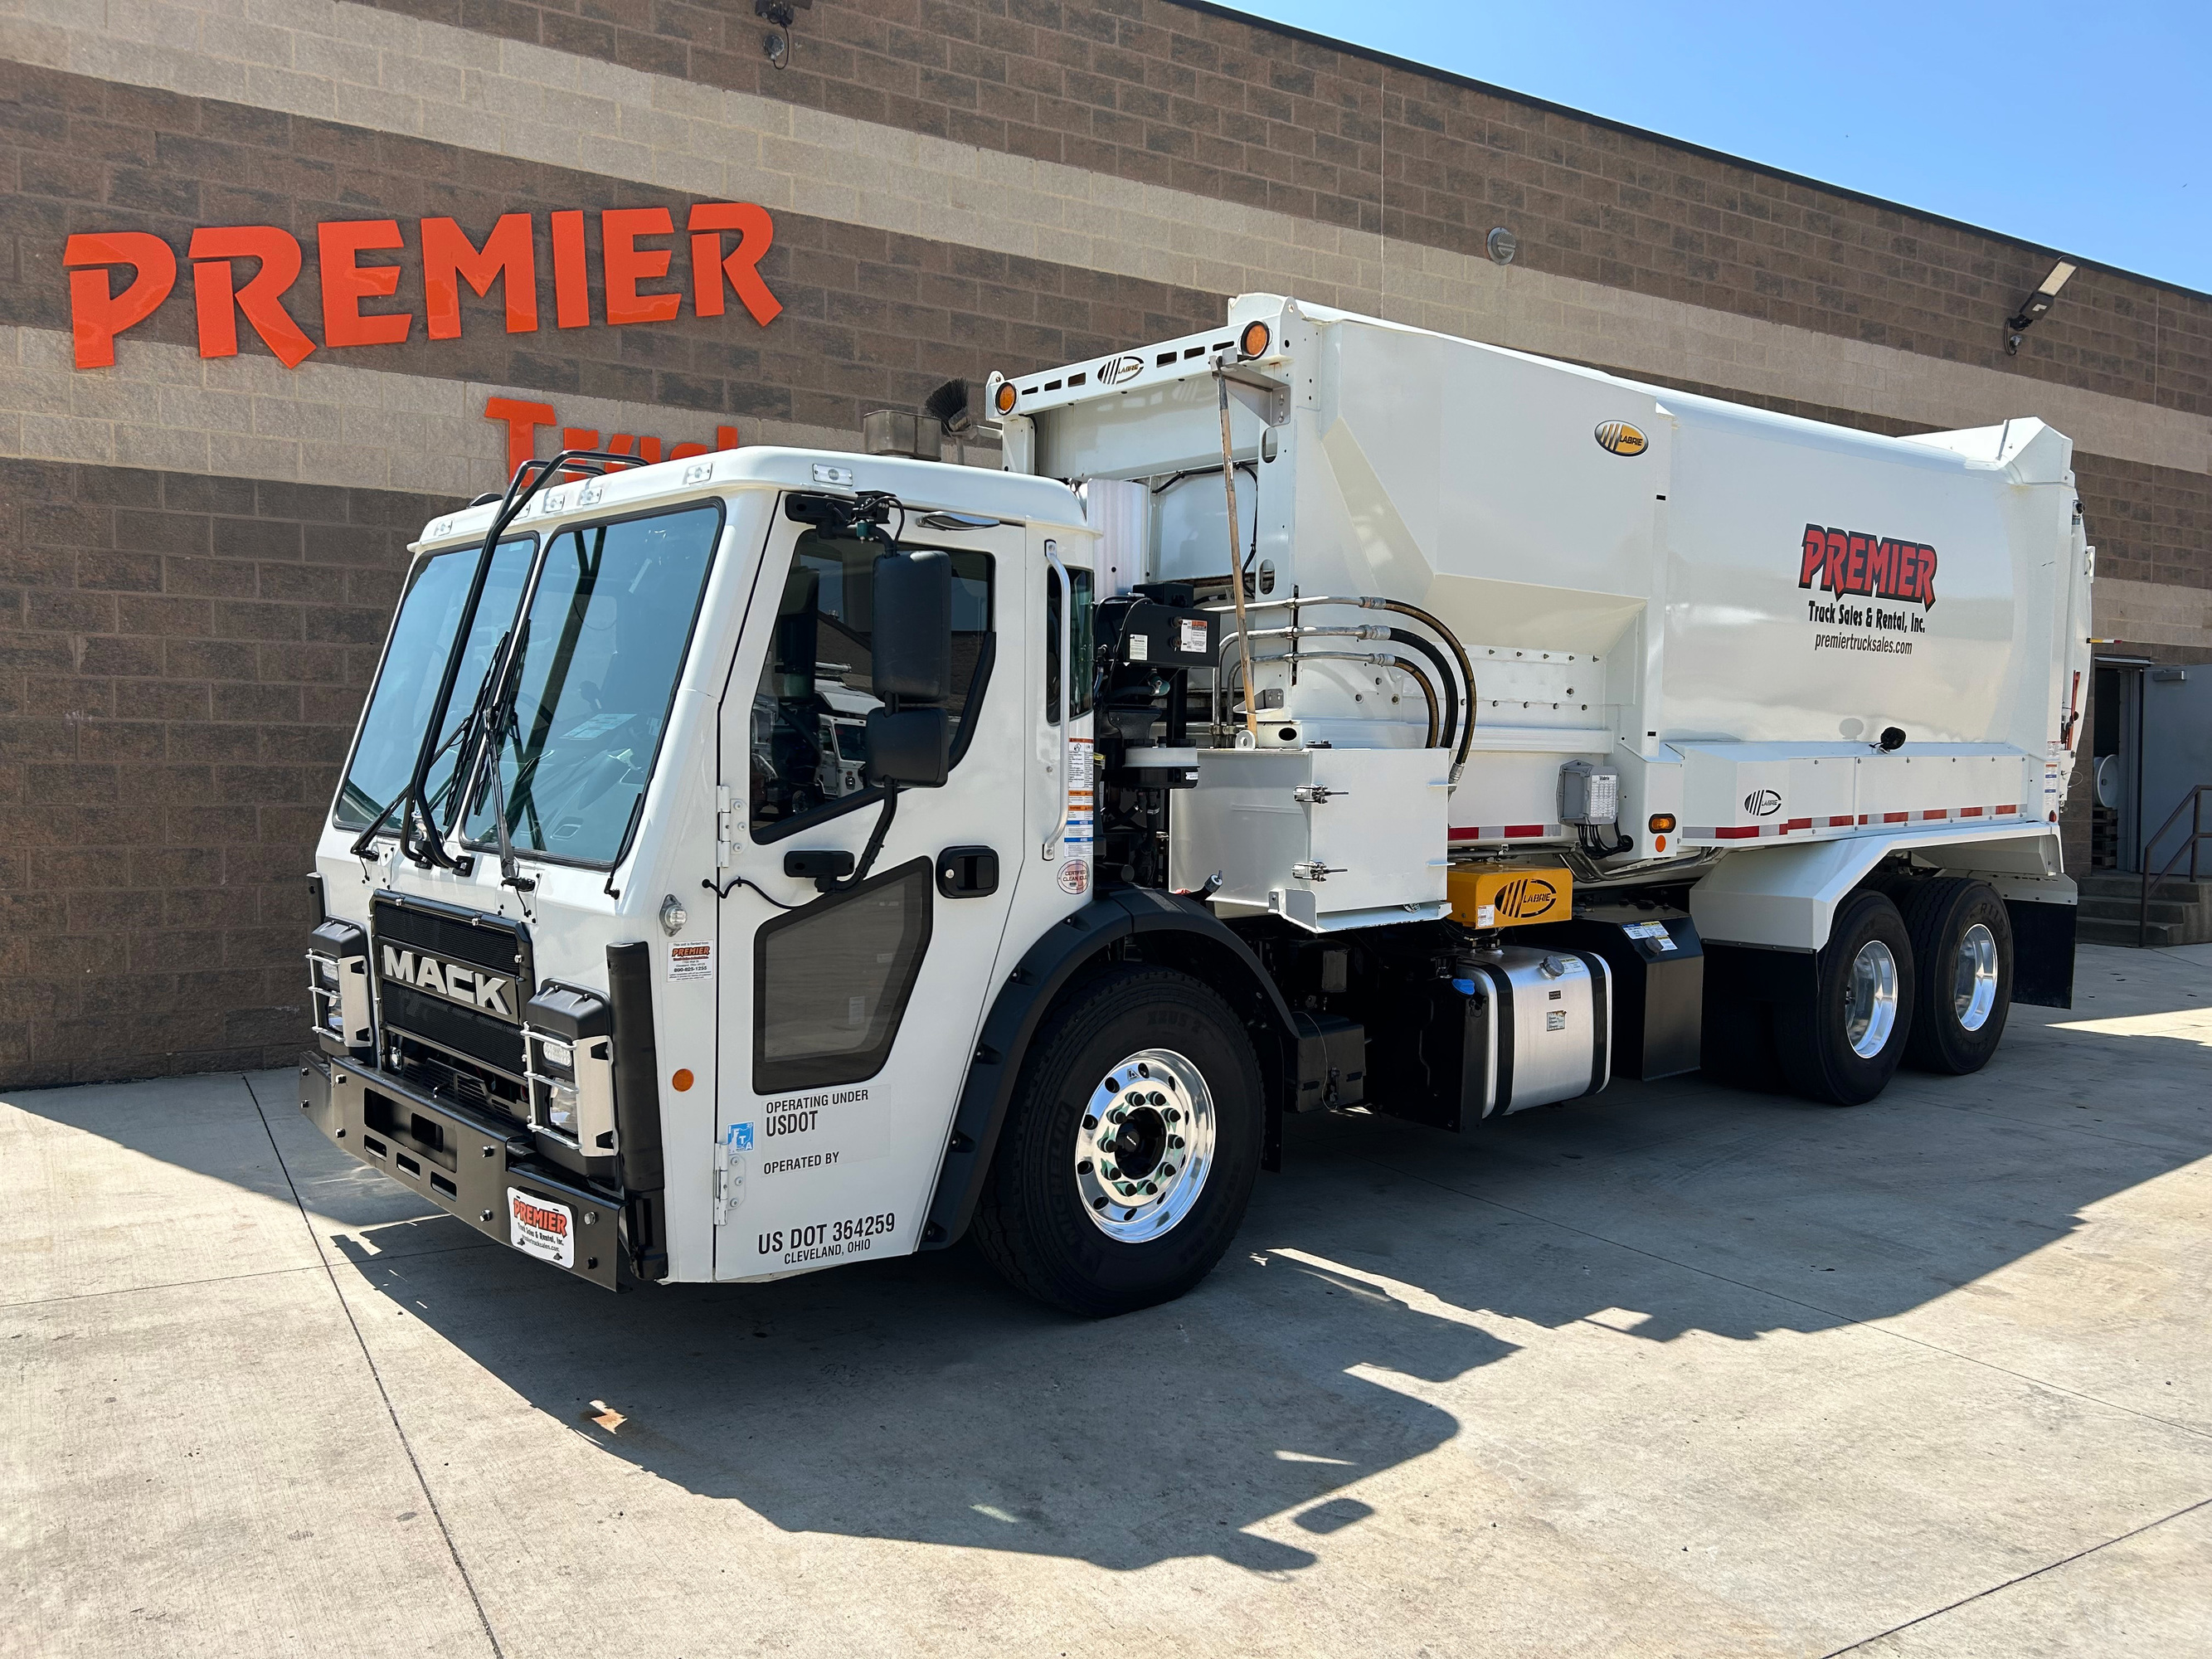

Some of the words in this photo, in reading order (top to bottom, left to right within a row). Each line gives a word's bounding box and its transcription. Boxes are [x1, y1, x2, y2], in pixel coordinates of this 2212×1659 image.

[62, 202, 784, 369] PREMIER
[1619, 435, 1643, 446] LABRIE
[1798, 523, 1937, 613] PREMIER
[1808, 601, 1835, 624] Truck
[1838, 605, 1863, 626] Sales
[1866, 607, 1873, 627] &
[1876, 609, 1908, 633] Rental,
[1910, 613, 1925, 633] Inc.
[1814, 632, 1913, 655] premiertrucksales.com
[1523, 893, 1551, 903] LABRIE
[672, 946, 710, 957] PREMIER
[383, 944, 512, 1016] MACK
[766, 1094, 829, 1114] OPERATING
[832, 1089, 869, 1105] UNDER
[766, 1111, 818, 1136] USDOT
[764, 1154, 821, 1175] OPERATED
[825, 1151, 840, 1165] BY
[513, 1197, 568, 1238] PREMIER
[758, 1231, 783, 1254] US
[790, 1224, 828, 1249] DOT
[832, 1212, 895, 1242] 364259
[784, 1243, 844, 1265] CLEVELAND,
[847, 1238, 871, 1253] OHIO
